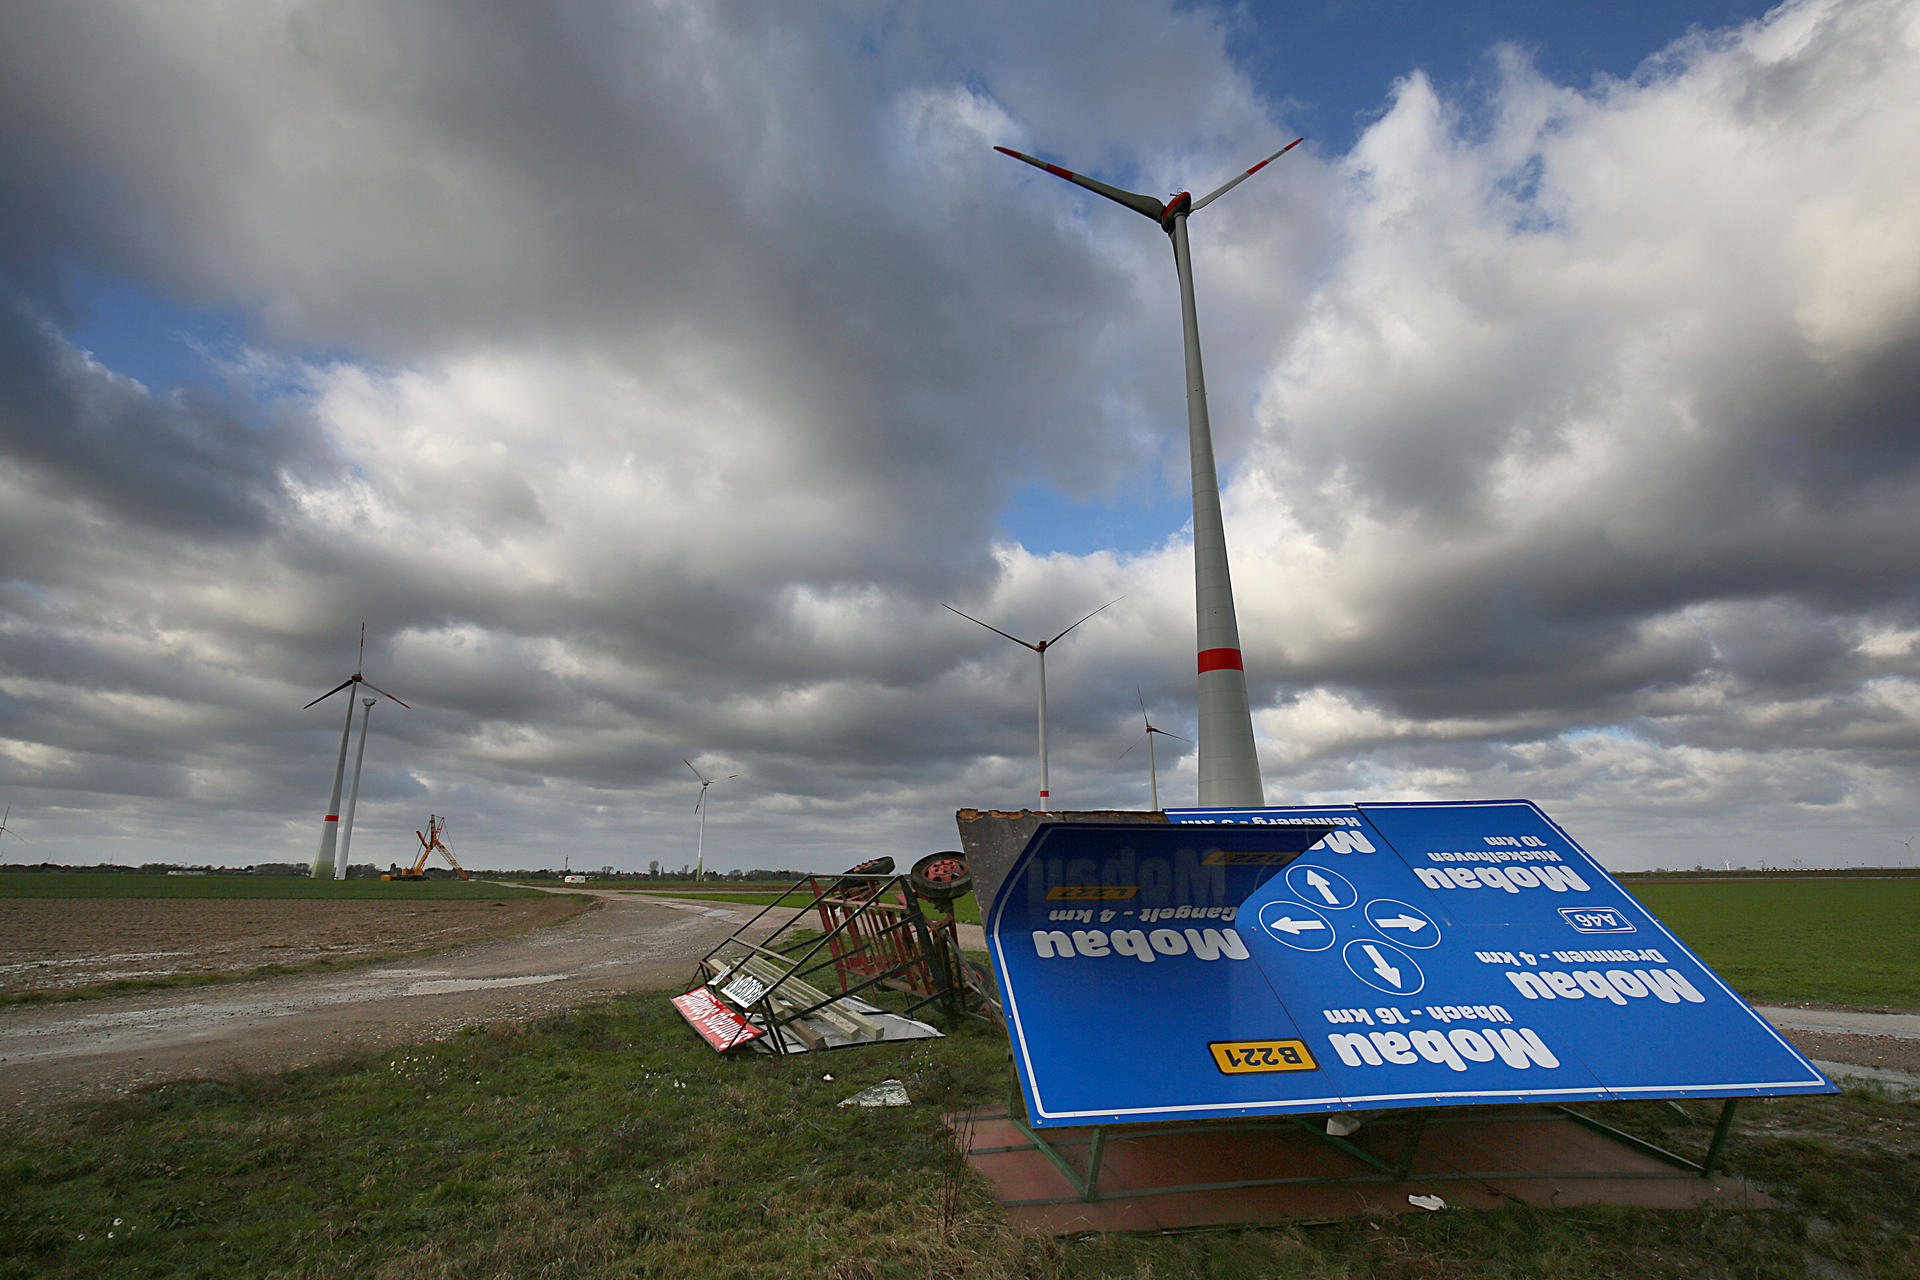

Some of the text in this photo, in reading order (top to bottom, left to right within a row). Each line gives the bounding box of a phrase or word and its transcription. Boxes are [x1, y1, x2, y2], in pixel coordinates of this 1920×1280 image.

[1483, 836, 1547, 847] 10 km
[1427, 850, 1563, 863] Hückelhoven
[1413, 865, 1591, 893] Mobau
[1049, 909, 1093, 923] km
[1100, 909, 1116, 923] 4
[1139, 905, 1238, 922] Gangelt
[1575, 913, 1617, 927] A46
[1032, 928, 1250, 962] Mobau
[1475, 951, 1521, 966] km
[1519, 951, 1538, 966] 4
[1553, 949, 1669, 963] Dremmen
[1505, 969, 1706, 1006] Mobau
[1323, 1009, 1375, 1025] km
[1376, 1007, 1411, 1024] 16
[1426, 1005, 1514, 1024] Übach
[1225, 1046, 1303, 1067] B221
[1328, 1028, 1560, 1072] Mobau
